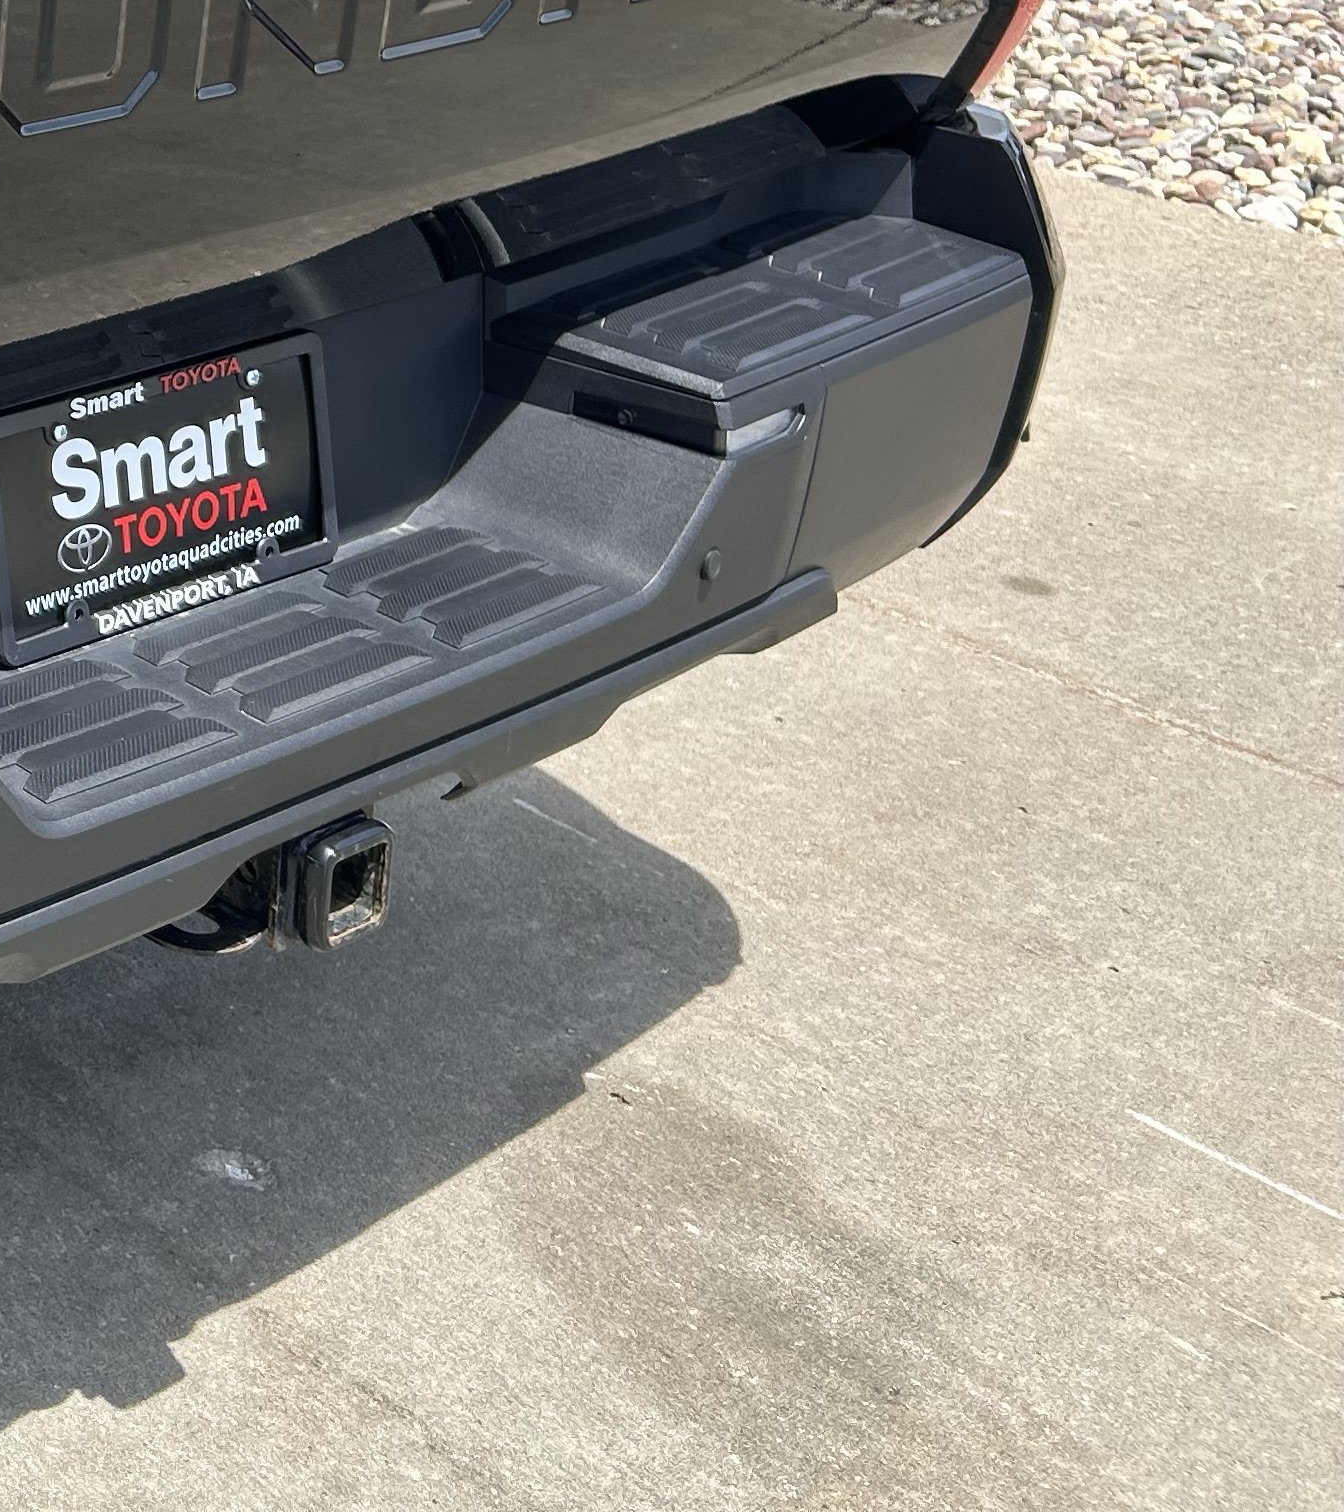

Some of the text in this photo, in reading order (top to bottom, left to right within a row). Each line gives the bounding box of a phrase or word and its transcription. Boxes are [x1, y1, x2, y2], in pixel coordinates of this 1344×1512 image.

[69, 356, 241, 420] Smart TOYOTA
[50, 396, 266, 520] Smart
[114, 478, 269, 554] TOYOTA
[25, 512, 301, 616] www.smarttoyotaquadcities.com
[94, 564, 261, 635] DAVENPORT, IA
